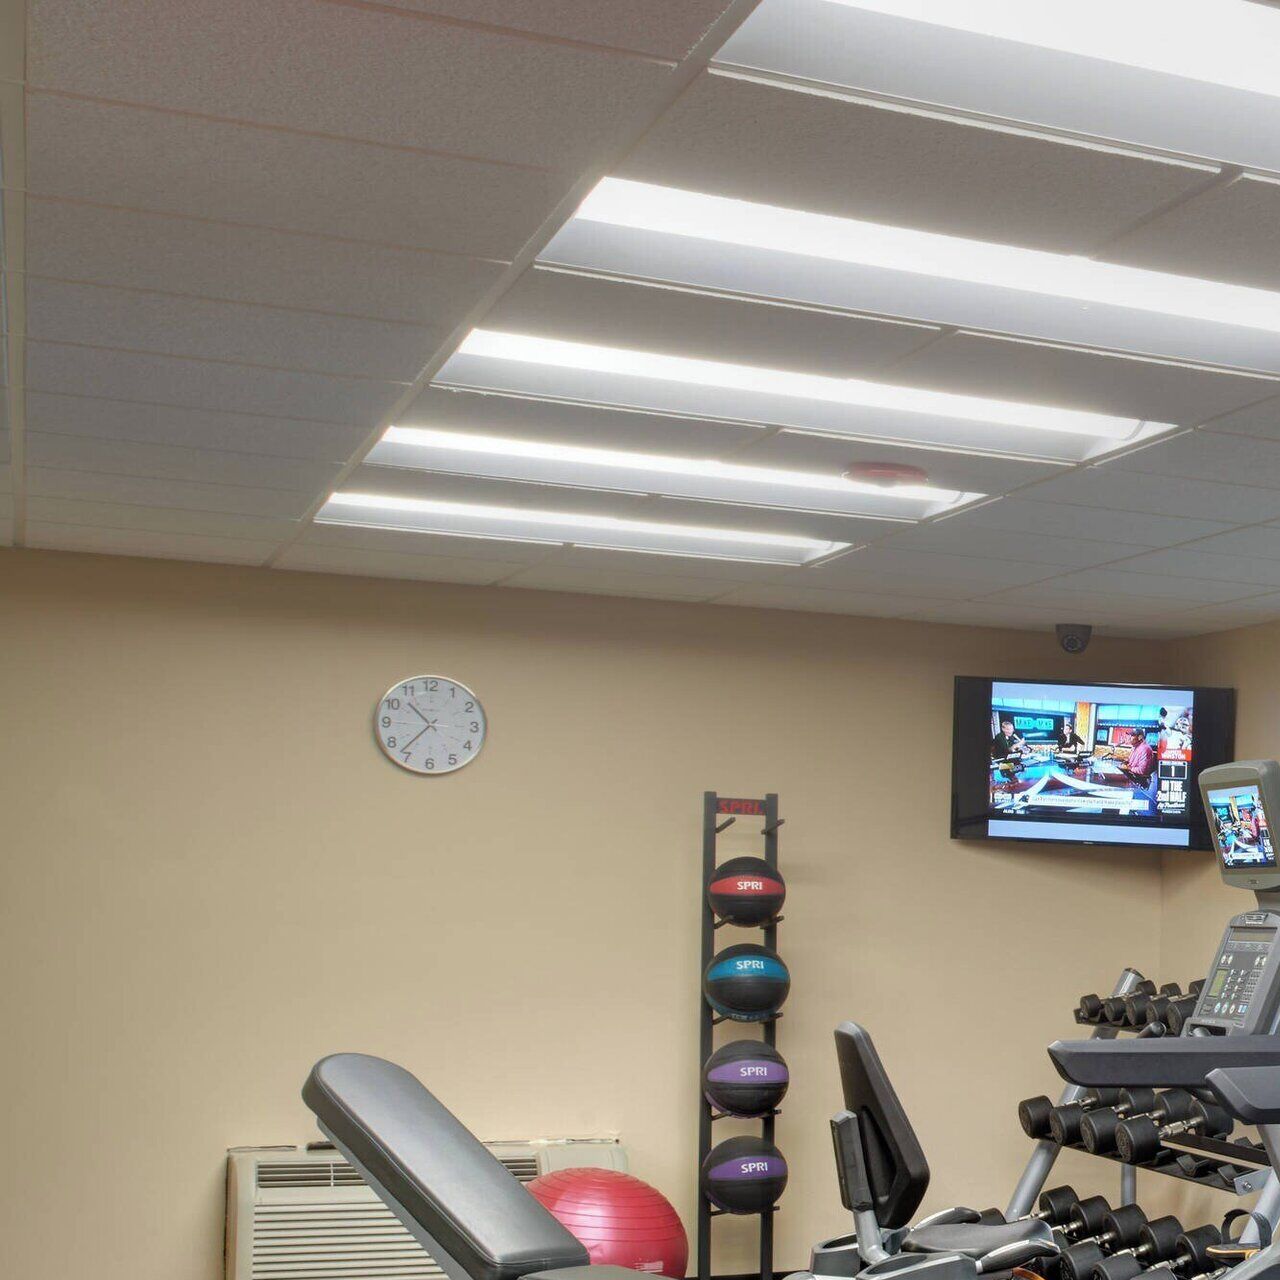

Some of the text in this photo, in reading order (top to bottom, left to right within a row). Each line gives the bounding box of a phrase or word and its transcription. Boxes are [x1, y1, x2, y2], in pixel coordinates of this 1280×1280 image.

[402, 685, 415, 696] 11
[423, 680, 438, 691] 12
[450, 688, 455, 698] 1
[386, 699, 400, 710] 10
[465, 702, 474, 712] 2
[382, 716, 392, 728] 9
[470, 722, 479, 733] 3
[387, 736, 396, 748] 8
[463, 741, 472, 751] 4
[403, 752, 411, 763] 7
[448, 754, 457, 765] 5
[425, 758, 435, 769] 6
[1171, 765, 1175, 777] 1
[1170, 781, 1183, 792] THE
[737, 881, 763, 890] SPRI
[736, 960, 764, 970] SPRI
[740, 1066, 767, 1077] SPRI
[741, 1162, 768, 1173] SPRI
